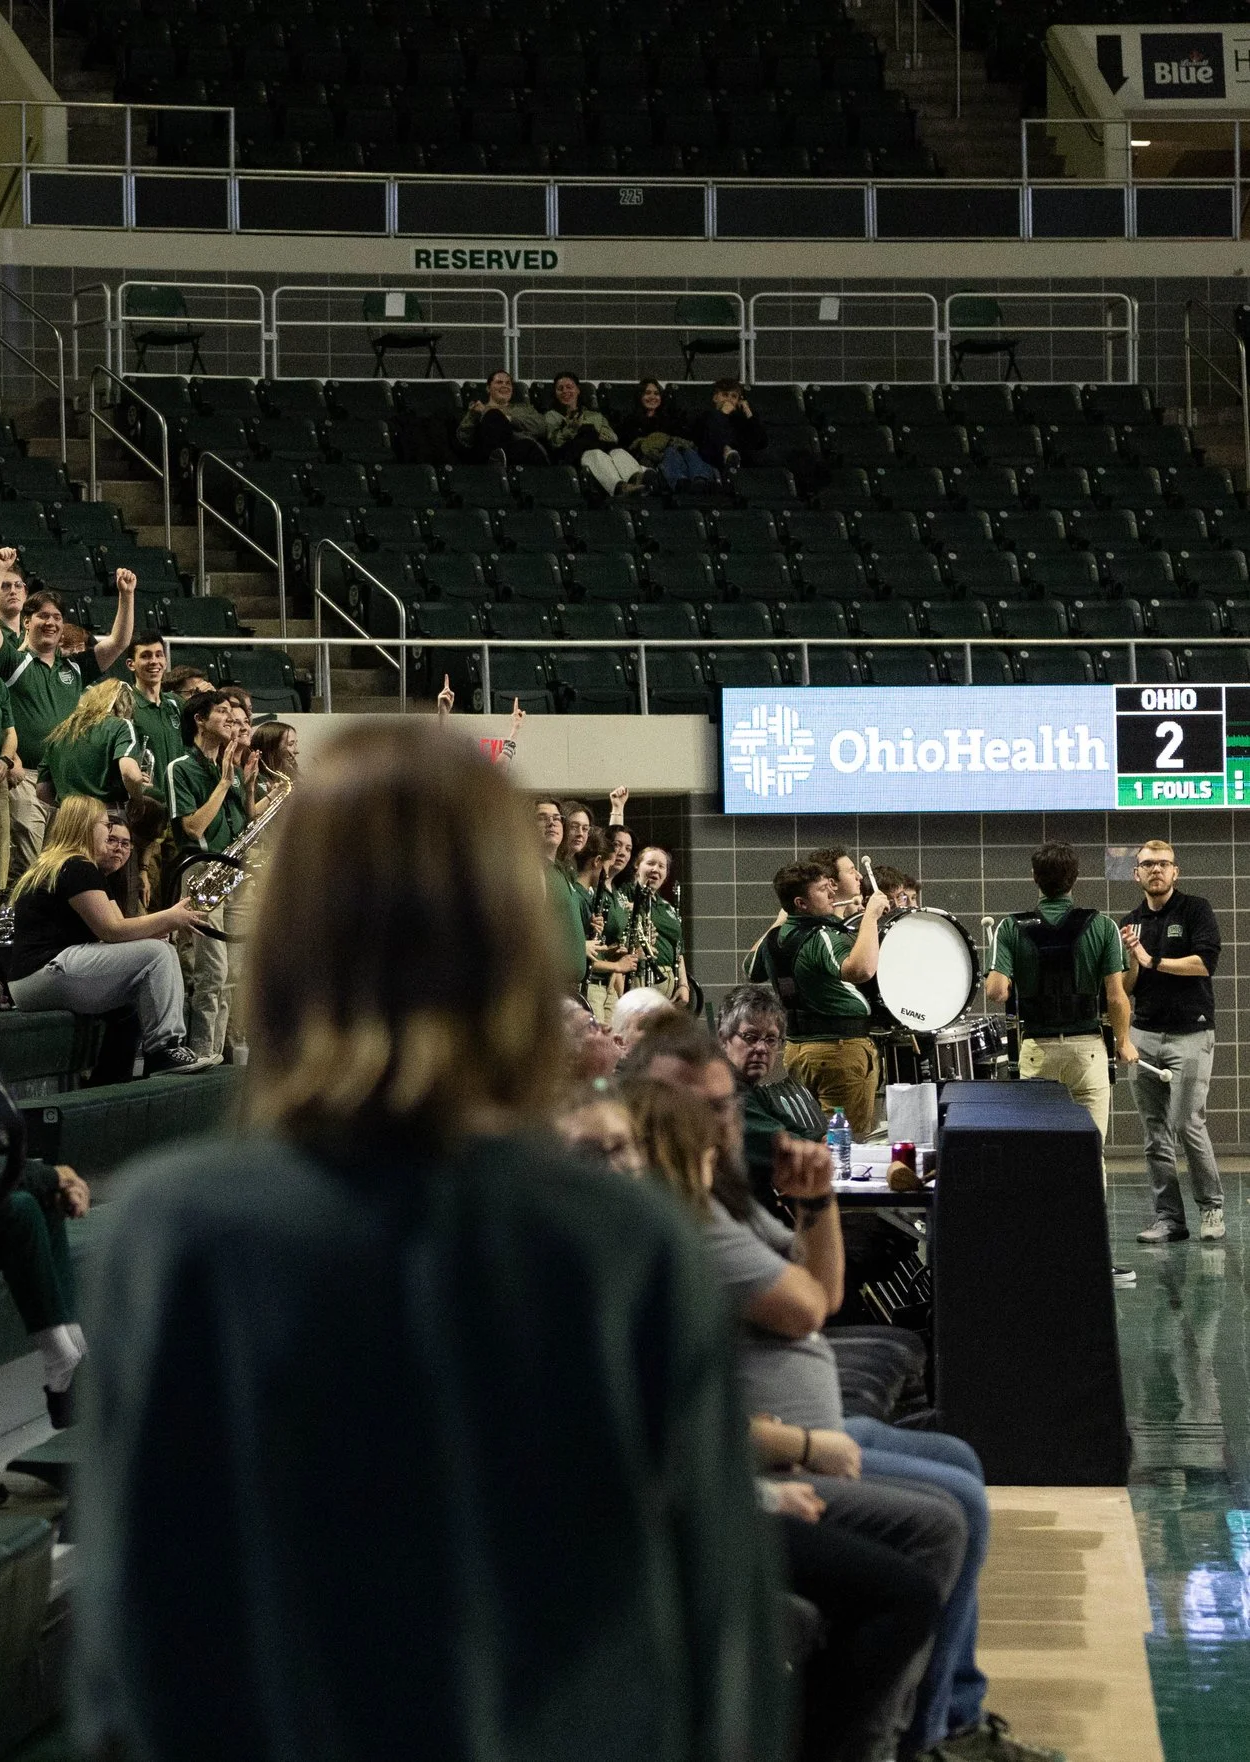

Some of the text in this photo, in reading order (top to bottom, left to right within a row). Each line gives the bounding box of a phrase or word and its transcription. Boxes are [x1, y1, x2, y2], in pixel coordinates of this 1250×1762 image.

[1154, 61, 1214, 84] Blue
[619, 187, 644, 205] 225
[414, 248, 558, 270] RESERVED
[1141, 688, 1197, 711] OHIO
[829, 724, 1110, 774] OhioHealth
[1155, 720, 1184, 769] 2
[1133, 780, 1212, 800] 1 FOULS
[900, 1007, 926, 1021] EVANS
